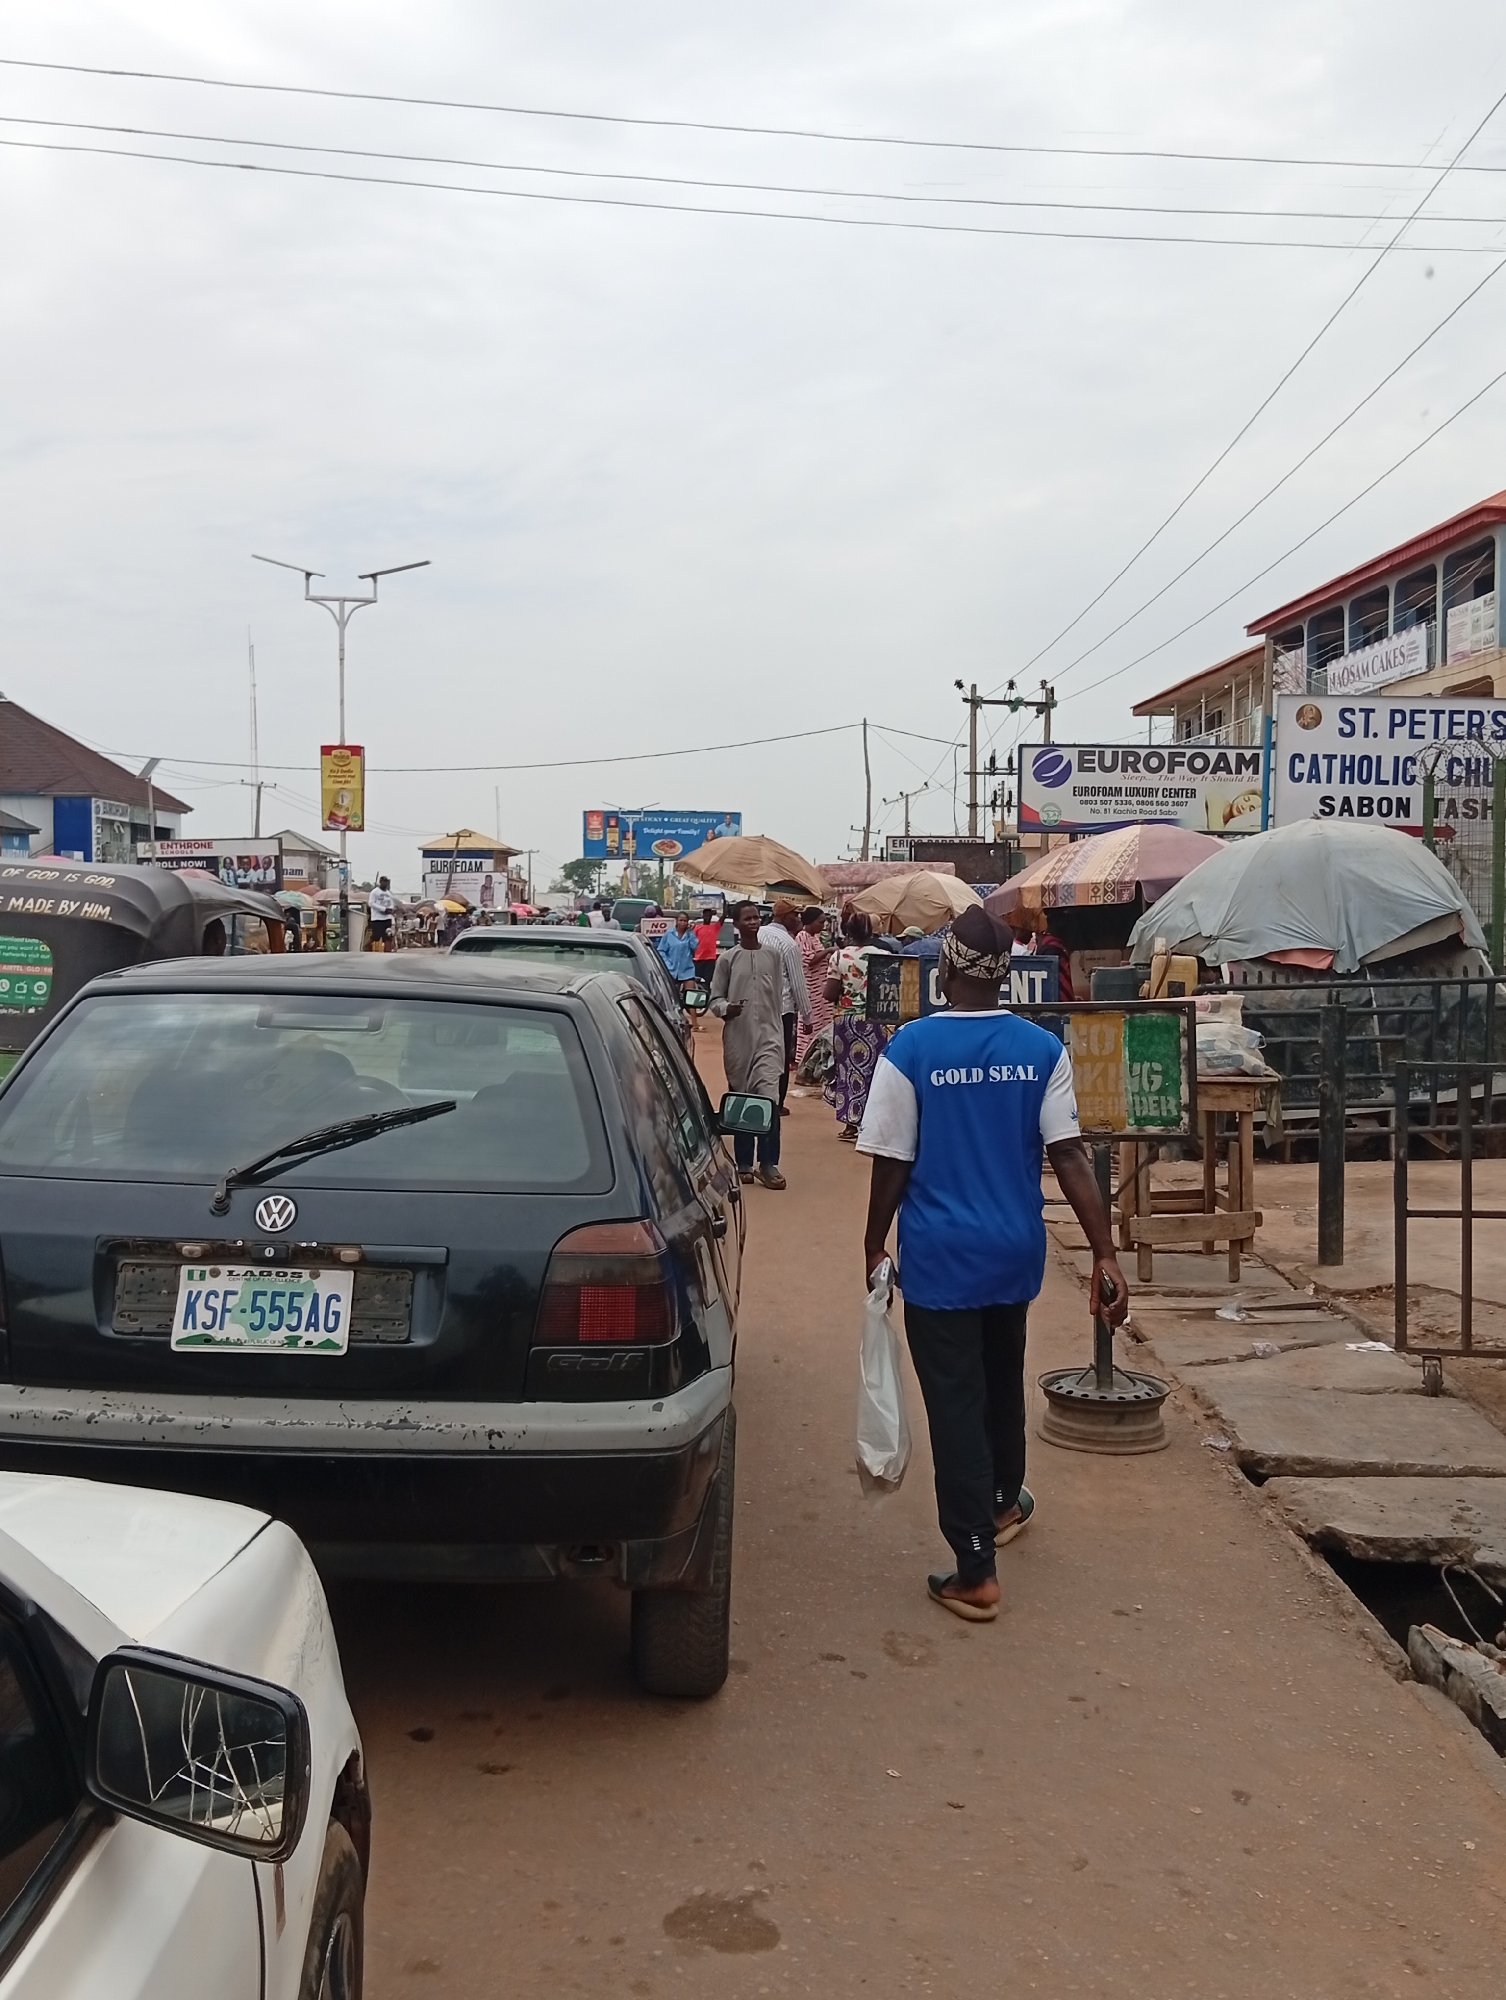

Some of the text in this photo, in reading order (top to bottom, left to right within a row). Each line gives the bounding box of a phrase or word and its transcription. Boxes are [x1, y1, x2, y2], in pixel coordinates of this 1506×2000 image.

[1372, 645, 1406, 676] CAKES
[1338, 707, 1506, 740] ST. PETER'S
[1077, 750, 1260, 775] EUROFOAM
[1288, 753, 1417, 786] CATHOLIC
[1178, 775, 1198, 783] Way
[1209, 775, 1244, 783] Should
[1072, 786, 1197, 798] EUROFOAM LUXURY CENTER
[1319, 795, 1411, 818] SABON
[160, 841, 213, 850] ENTHRONE
[180, 860, 207, 868] NOW!
[1, 868, 116, 888] OF GOD IS GOD,
[7, 897, 55, 914] MADE
[57, 900, 80, 915] BY
[80, 902, 112, 920] HIM.
[2, 964, 23, 972] AIRTEL
[1064, 1023, 1116, 1057] NO
[930, 1065, 1039, 1087] GOLD SEAL
[226, 1269, 303, 1279] LAGOS
[547, 1353, 645, 1371] Golf
